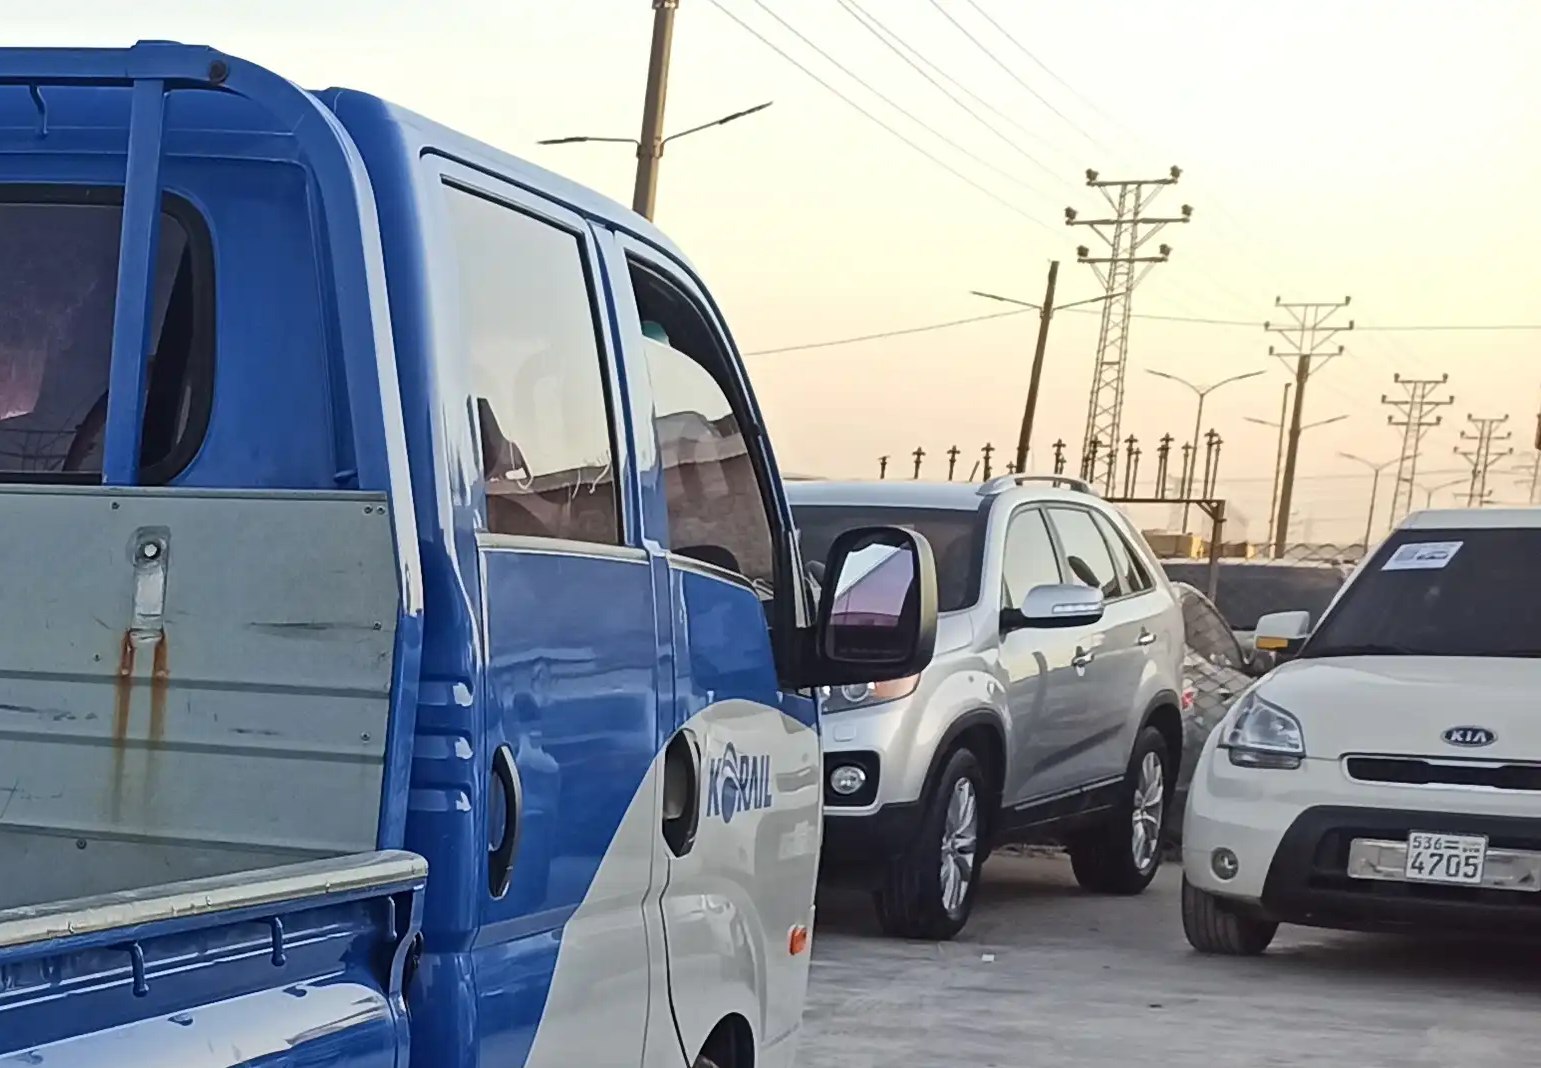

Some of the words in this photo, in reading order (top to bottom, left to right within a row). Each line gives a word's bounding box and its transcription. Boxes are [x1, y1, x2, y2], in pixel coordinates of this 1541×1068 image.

[1450, 730, 1487, 742] KIA
[1412, 835, 1443, 850] 536
[1410, 851, 1480, 879] 4705
